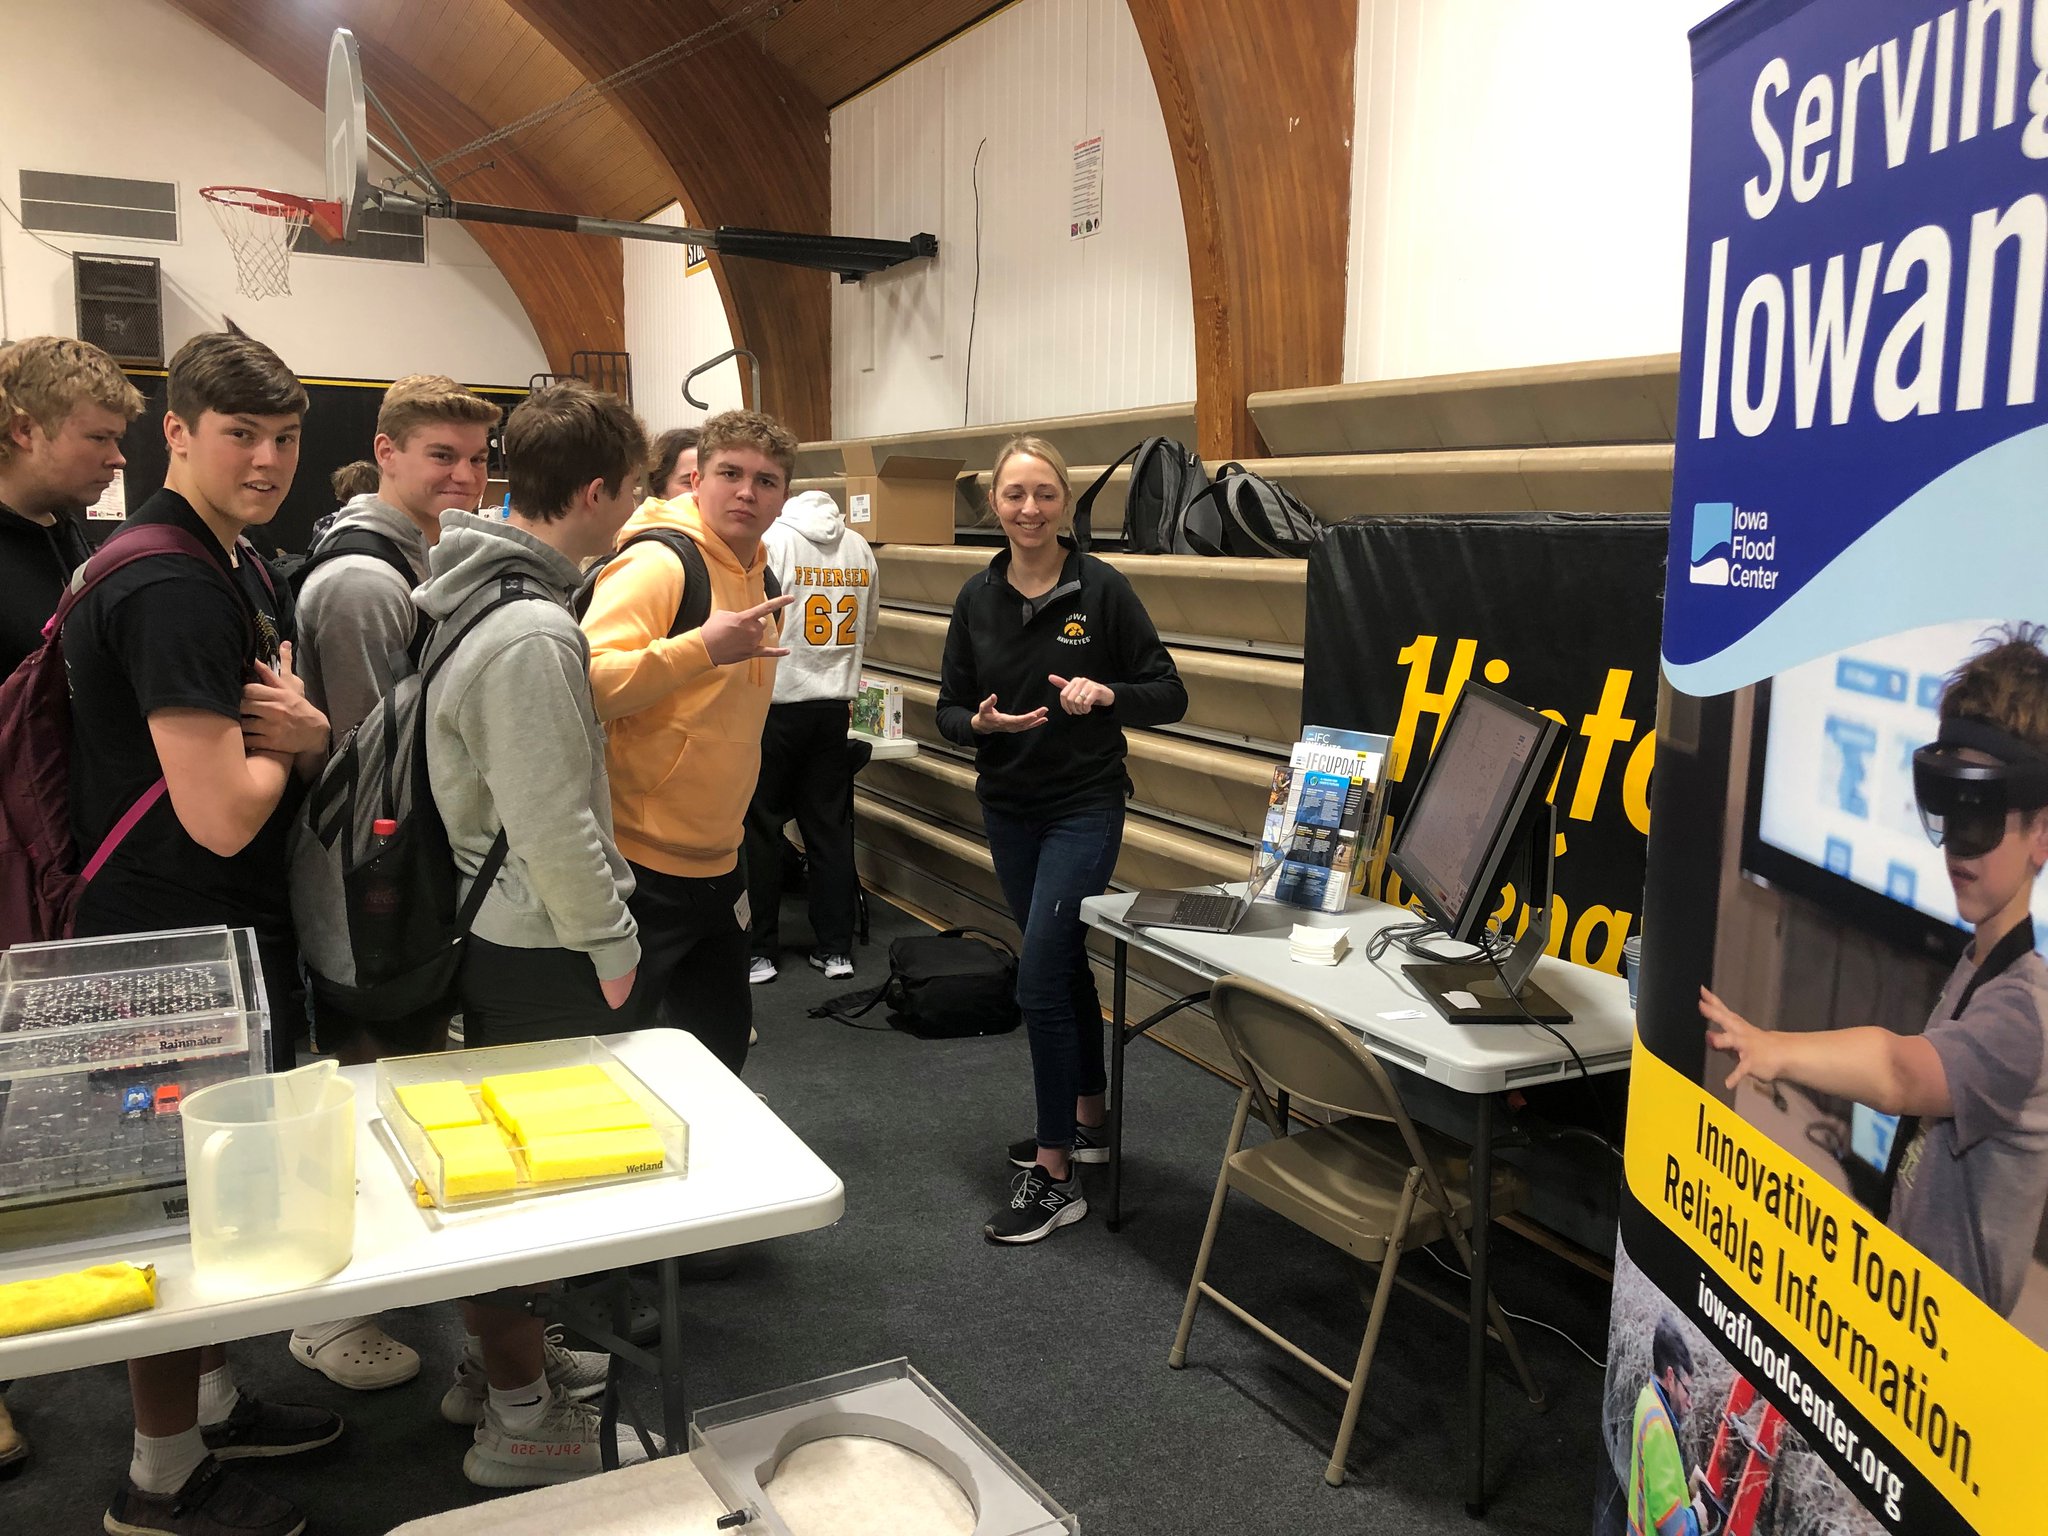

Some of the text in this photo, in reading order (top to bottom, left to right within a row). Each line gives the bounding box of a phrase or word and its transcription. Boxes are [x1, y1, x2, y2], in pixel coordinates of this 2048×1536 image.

[1699, 193, 2048, 440] Iowan
[1733, 506, 1768, 531] Iowa
[1731, 535, 1776, 561] Flood
[795, 566, 870, 588] PETERSEN
[1730, 563, 1779, 590] Center
[804, 594, 859, 646] 62
[1065, 613, 1087, 623] IOWA
[1056, 635, 1091, 646] HAWKEYES
[1314, 732, 1331, 744] IFC
[159, 1036, 223, 1050] Rainmaker
[626, 1160, 664, 1173] Wetland
[1695, 1102, 1839, 1264] Innovative
[1851, 1218, 1950, 1362] Tools.
[1664, 1152, 1981, 1498] Reliable Information.
[1697, 1272, 1905, 1522] iowafloodcenter.org
